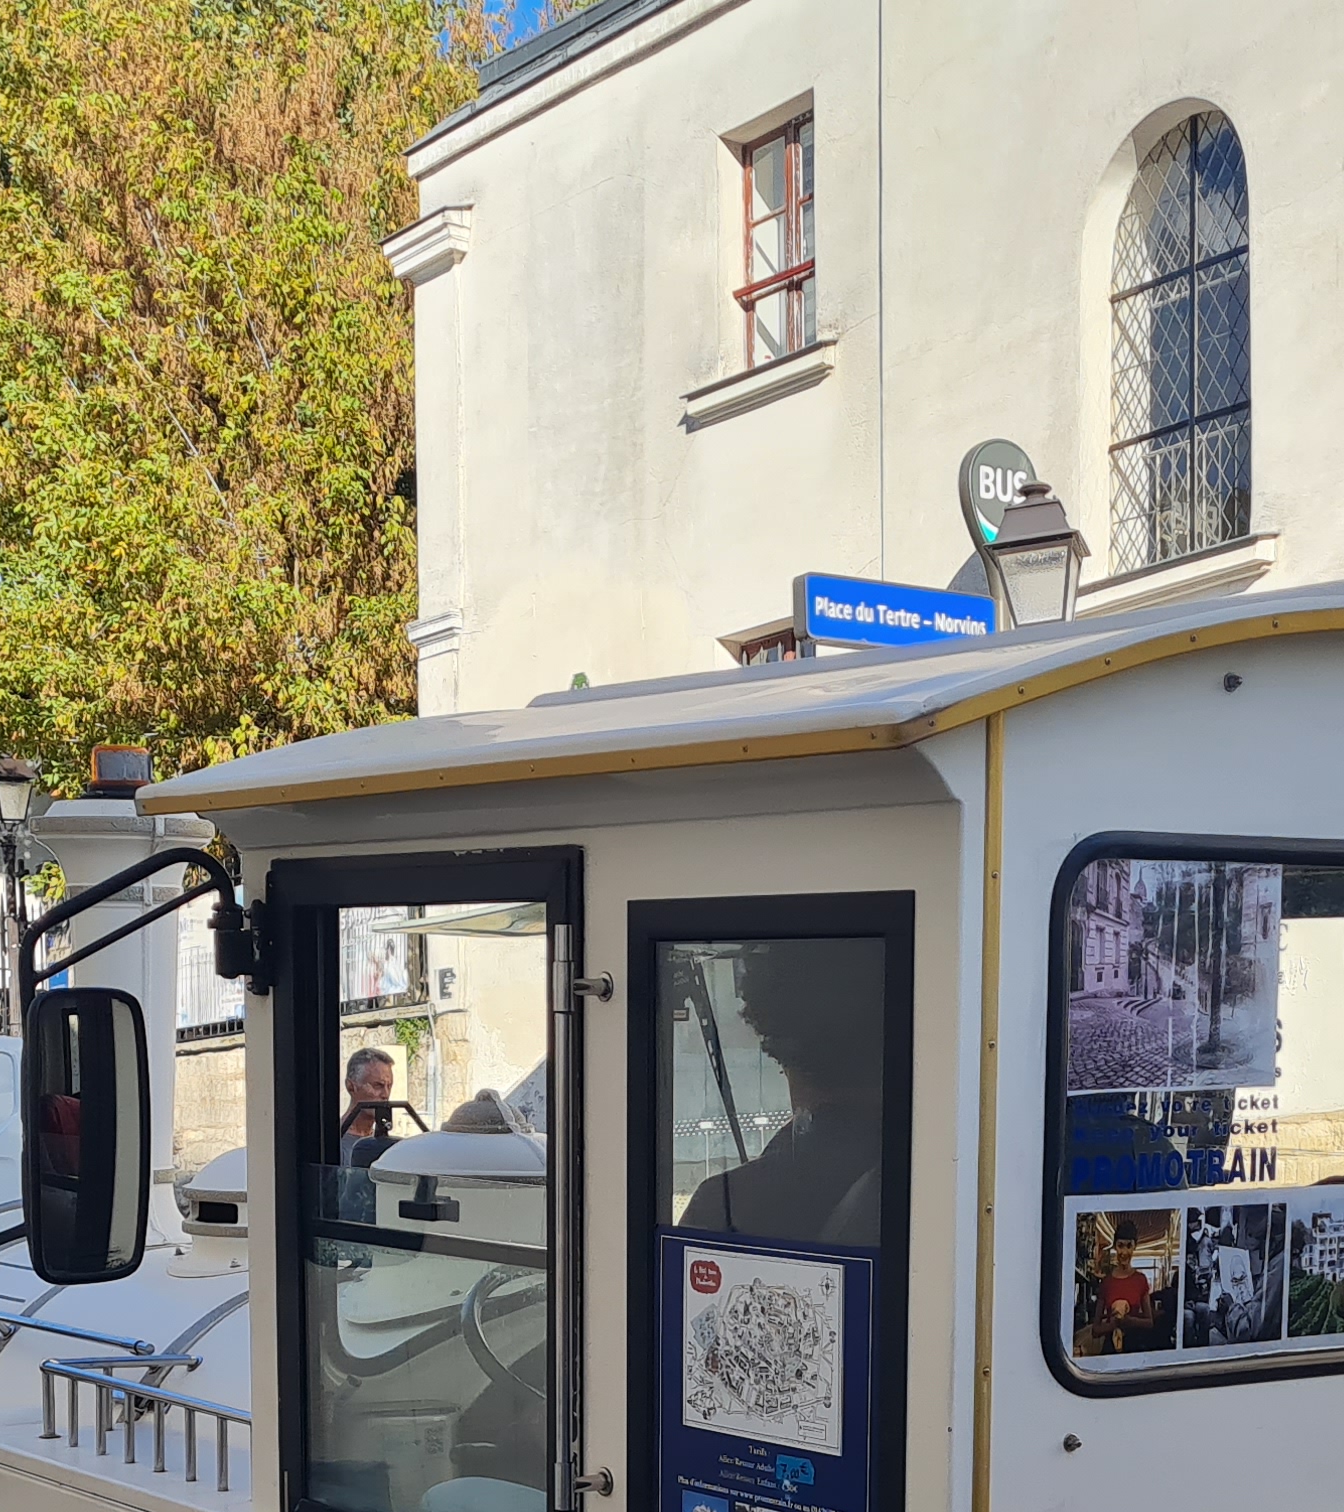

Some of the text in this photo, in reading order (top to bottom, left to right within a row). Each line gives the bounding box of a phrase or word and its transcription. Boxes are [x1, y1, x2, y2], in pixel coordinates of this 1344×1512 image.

[979, 464, 1028, 505] BUS
[814, 596, 852, 621] Place
[855, 602, 875, 623] du
[877, 604, 921, 629] Tertre
[934, 612, 987, 636] Norvins
[1150, 1124, 1198, 1142] your
[1213, 1118, 1279, 1138] ticket
[1071, 1147, 1278, 1193] PROMOTRAIN
